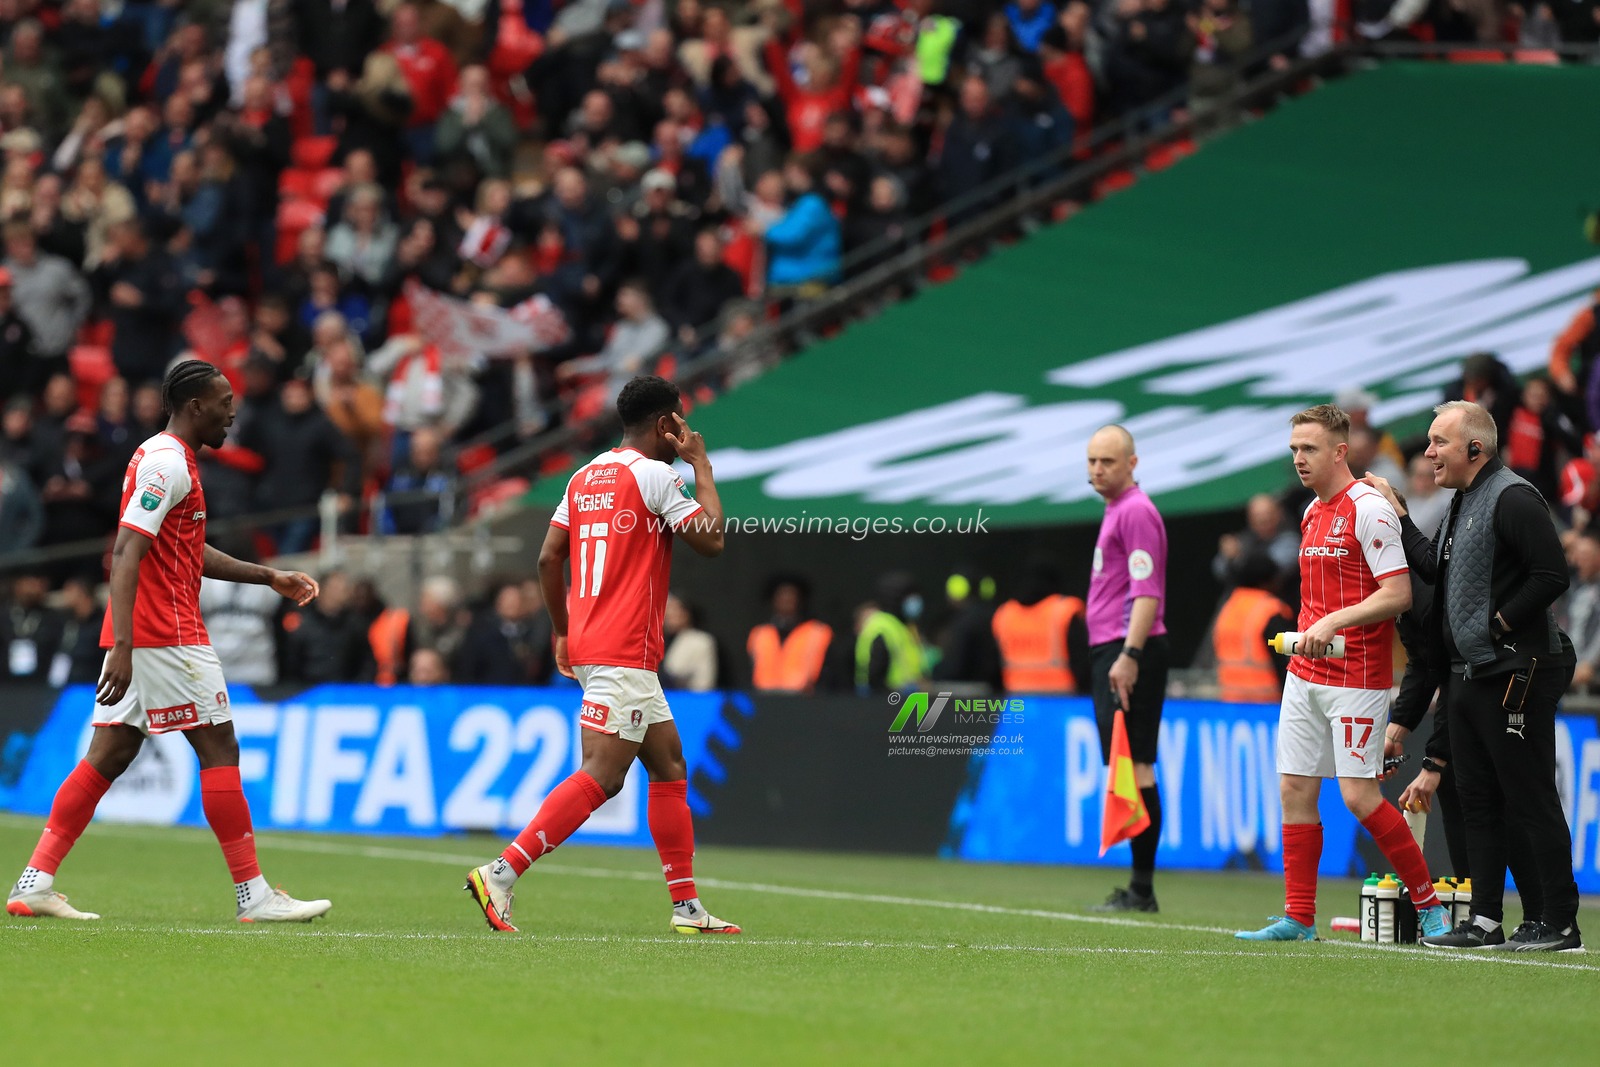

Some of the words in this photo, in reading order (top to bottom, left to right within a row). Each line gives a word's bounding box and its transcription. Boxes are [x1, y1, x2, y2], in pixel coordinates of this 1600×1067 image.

[579, 523, 609, 598] 11
[1304, 546, 1349, 557] GROUP
[151, 708, 194, 725] MEARS
[1508, 713, 1524, 724] MH
[1340, 717, 1374, 748] 17
[441, 704, 570, 829] 22
[1066, 715, 1188, 847] PY
